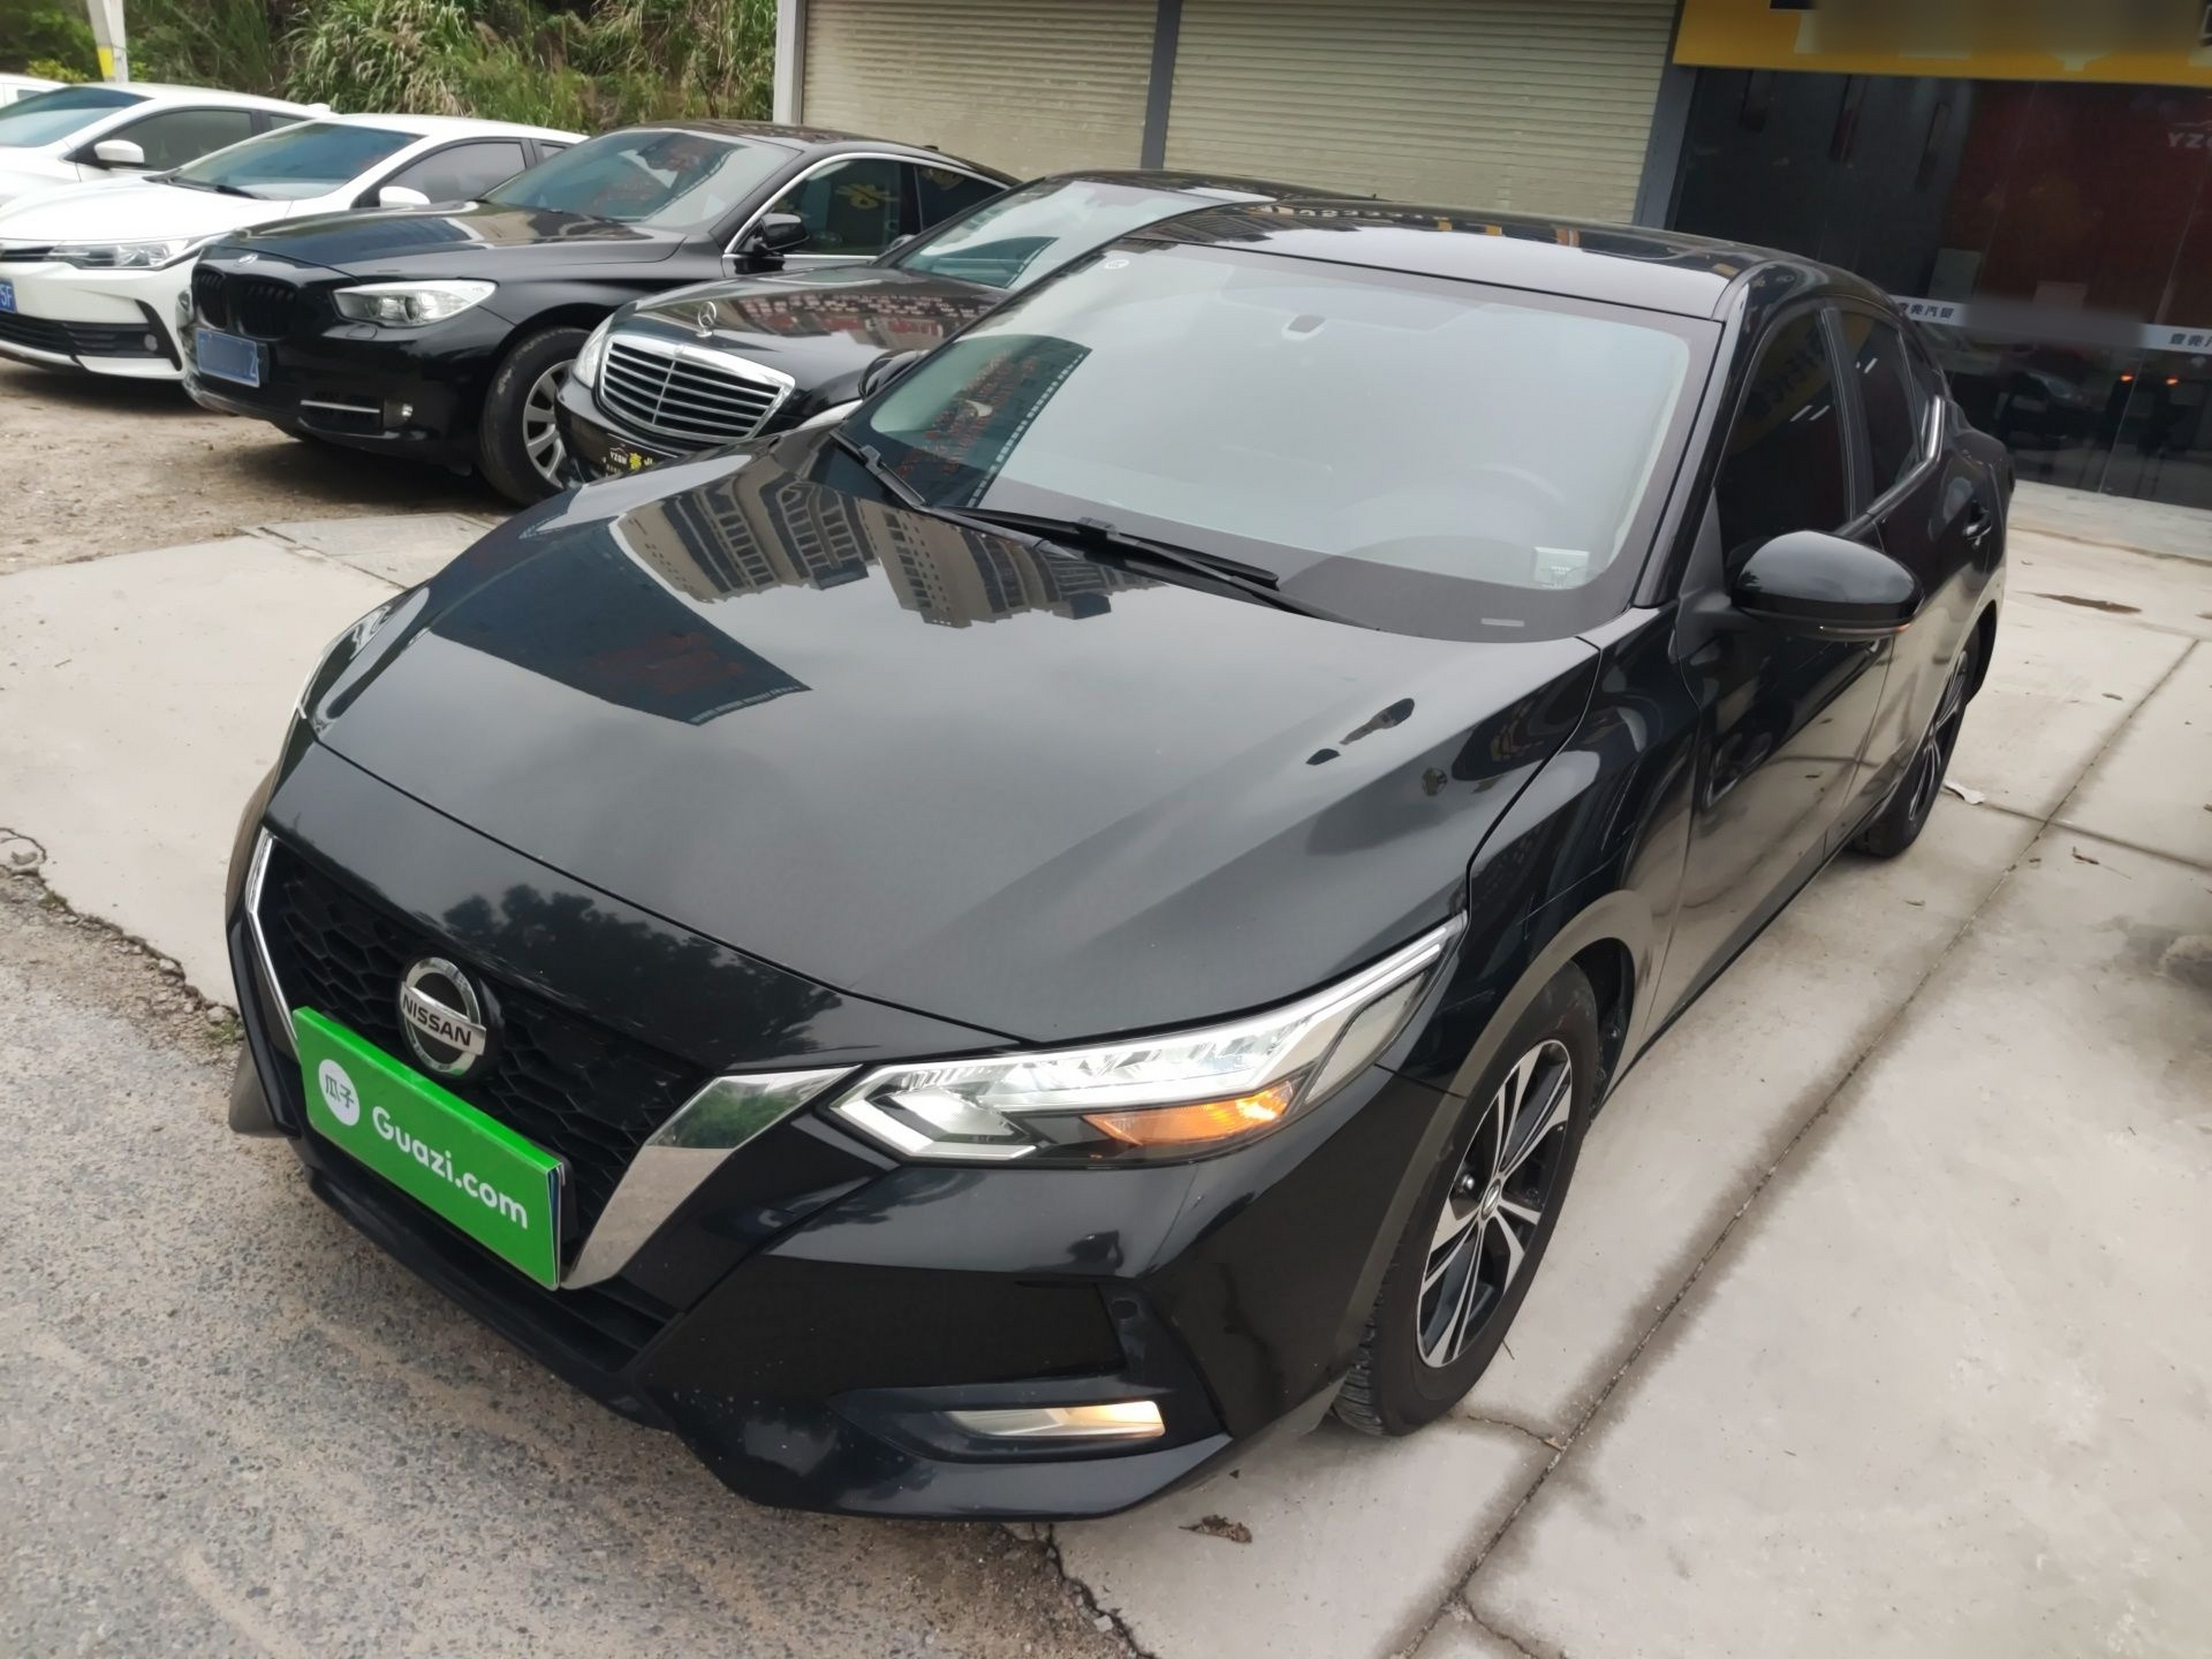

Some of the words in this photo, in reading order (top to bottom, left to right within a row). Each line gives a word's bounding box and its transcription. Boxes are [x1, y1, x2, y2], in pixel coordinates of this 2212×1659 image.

[403, 994, 471, 1047] NISSAN
[325, 1074, 354, 1109] 瓜子
[372, 1105, 528, 1229] Guazi.com
